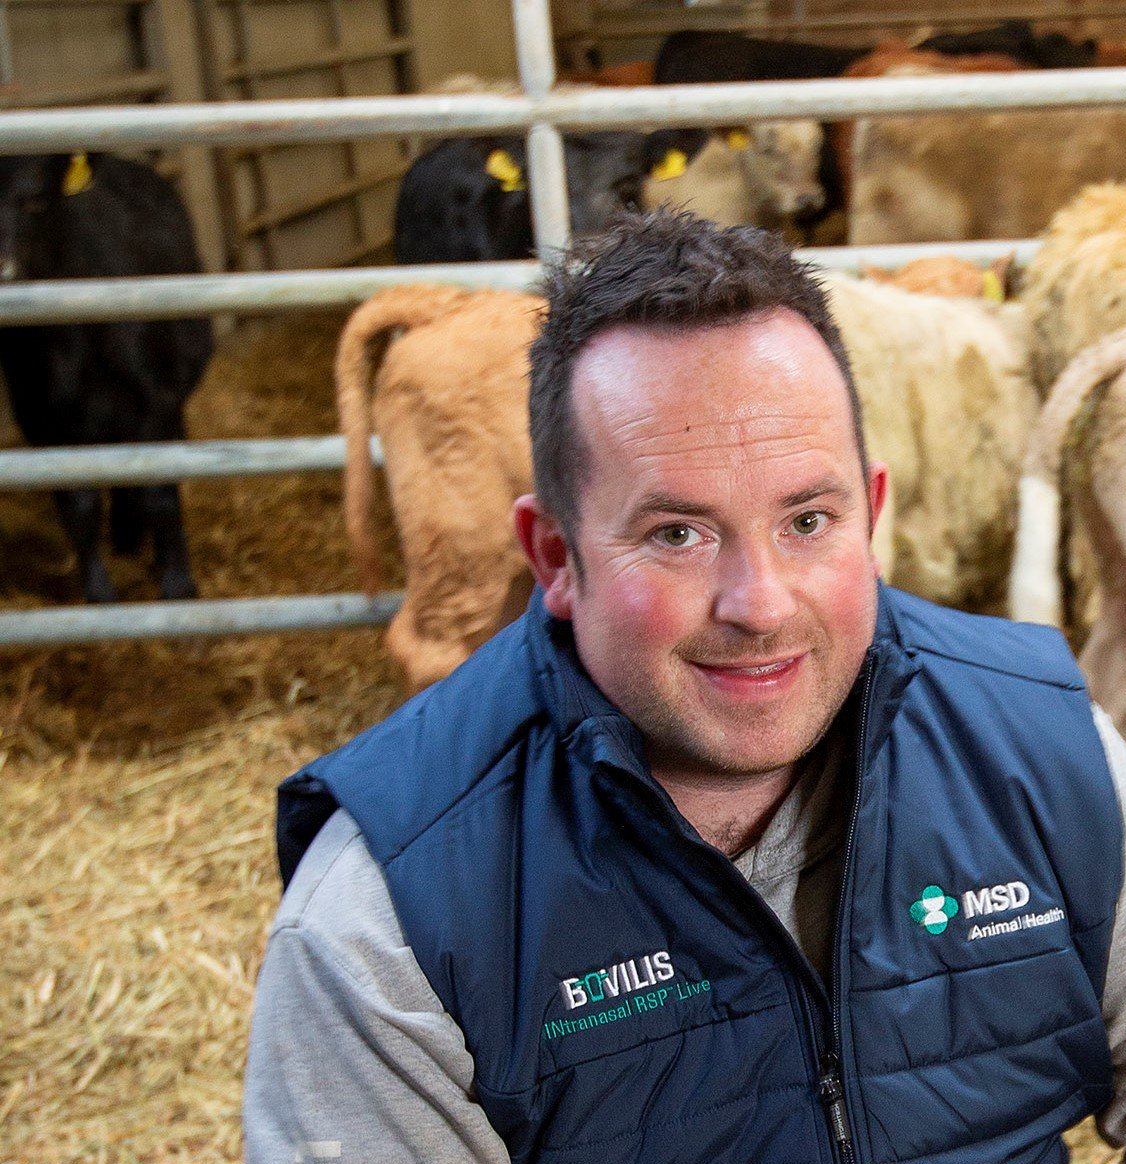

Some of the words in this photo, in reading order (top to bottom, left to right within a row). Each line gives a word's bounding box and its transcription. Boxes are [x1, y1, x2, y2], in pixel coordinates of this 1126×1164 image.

[962, 881, 1030, 919] MSD
[968, 917, 1021, 940] Animal
[1022, 907, 1065, 930] Health
[559, 951, 675, 1010] BOVILIS
[544, 1001, 633, 1039] INtranasal
[676, 979, 711, 1001] Live
